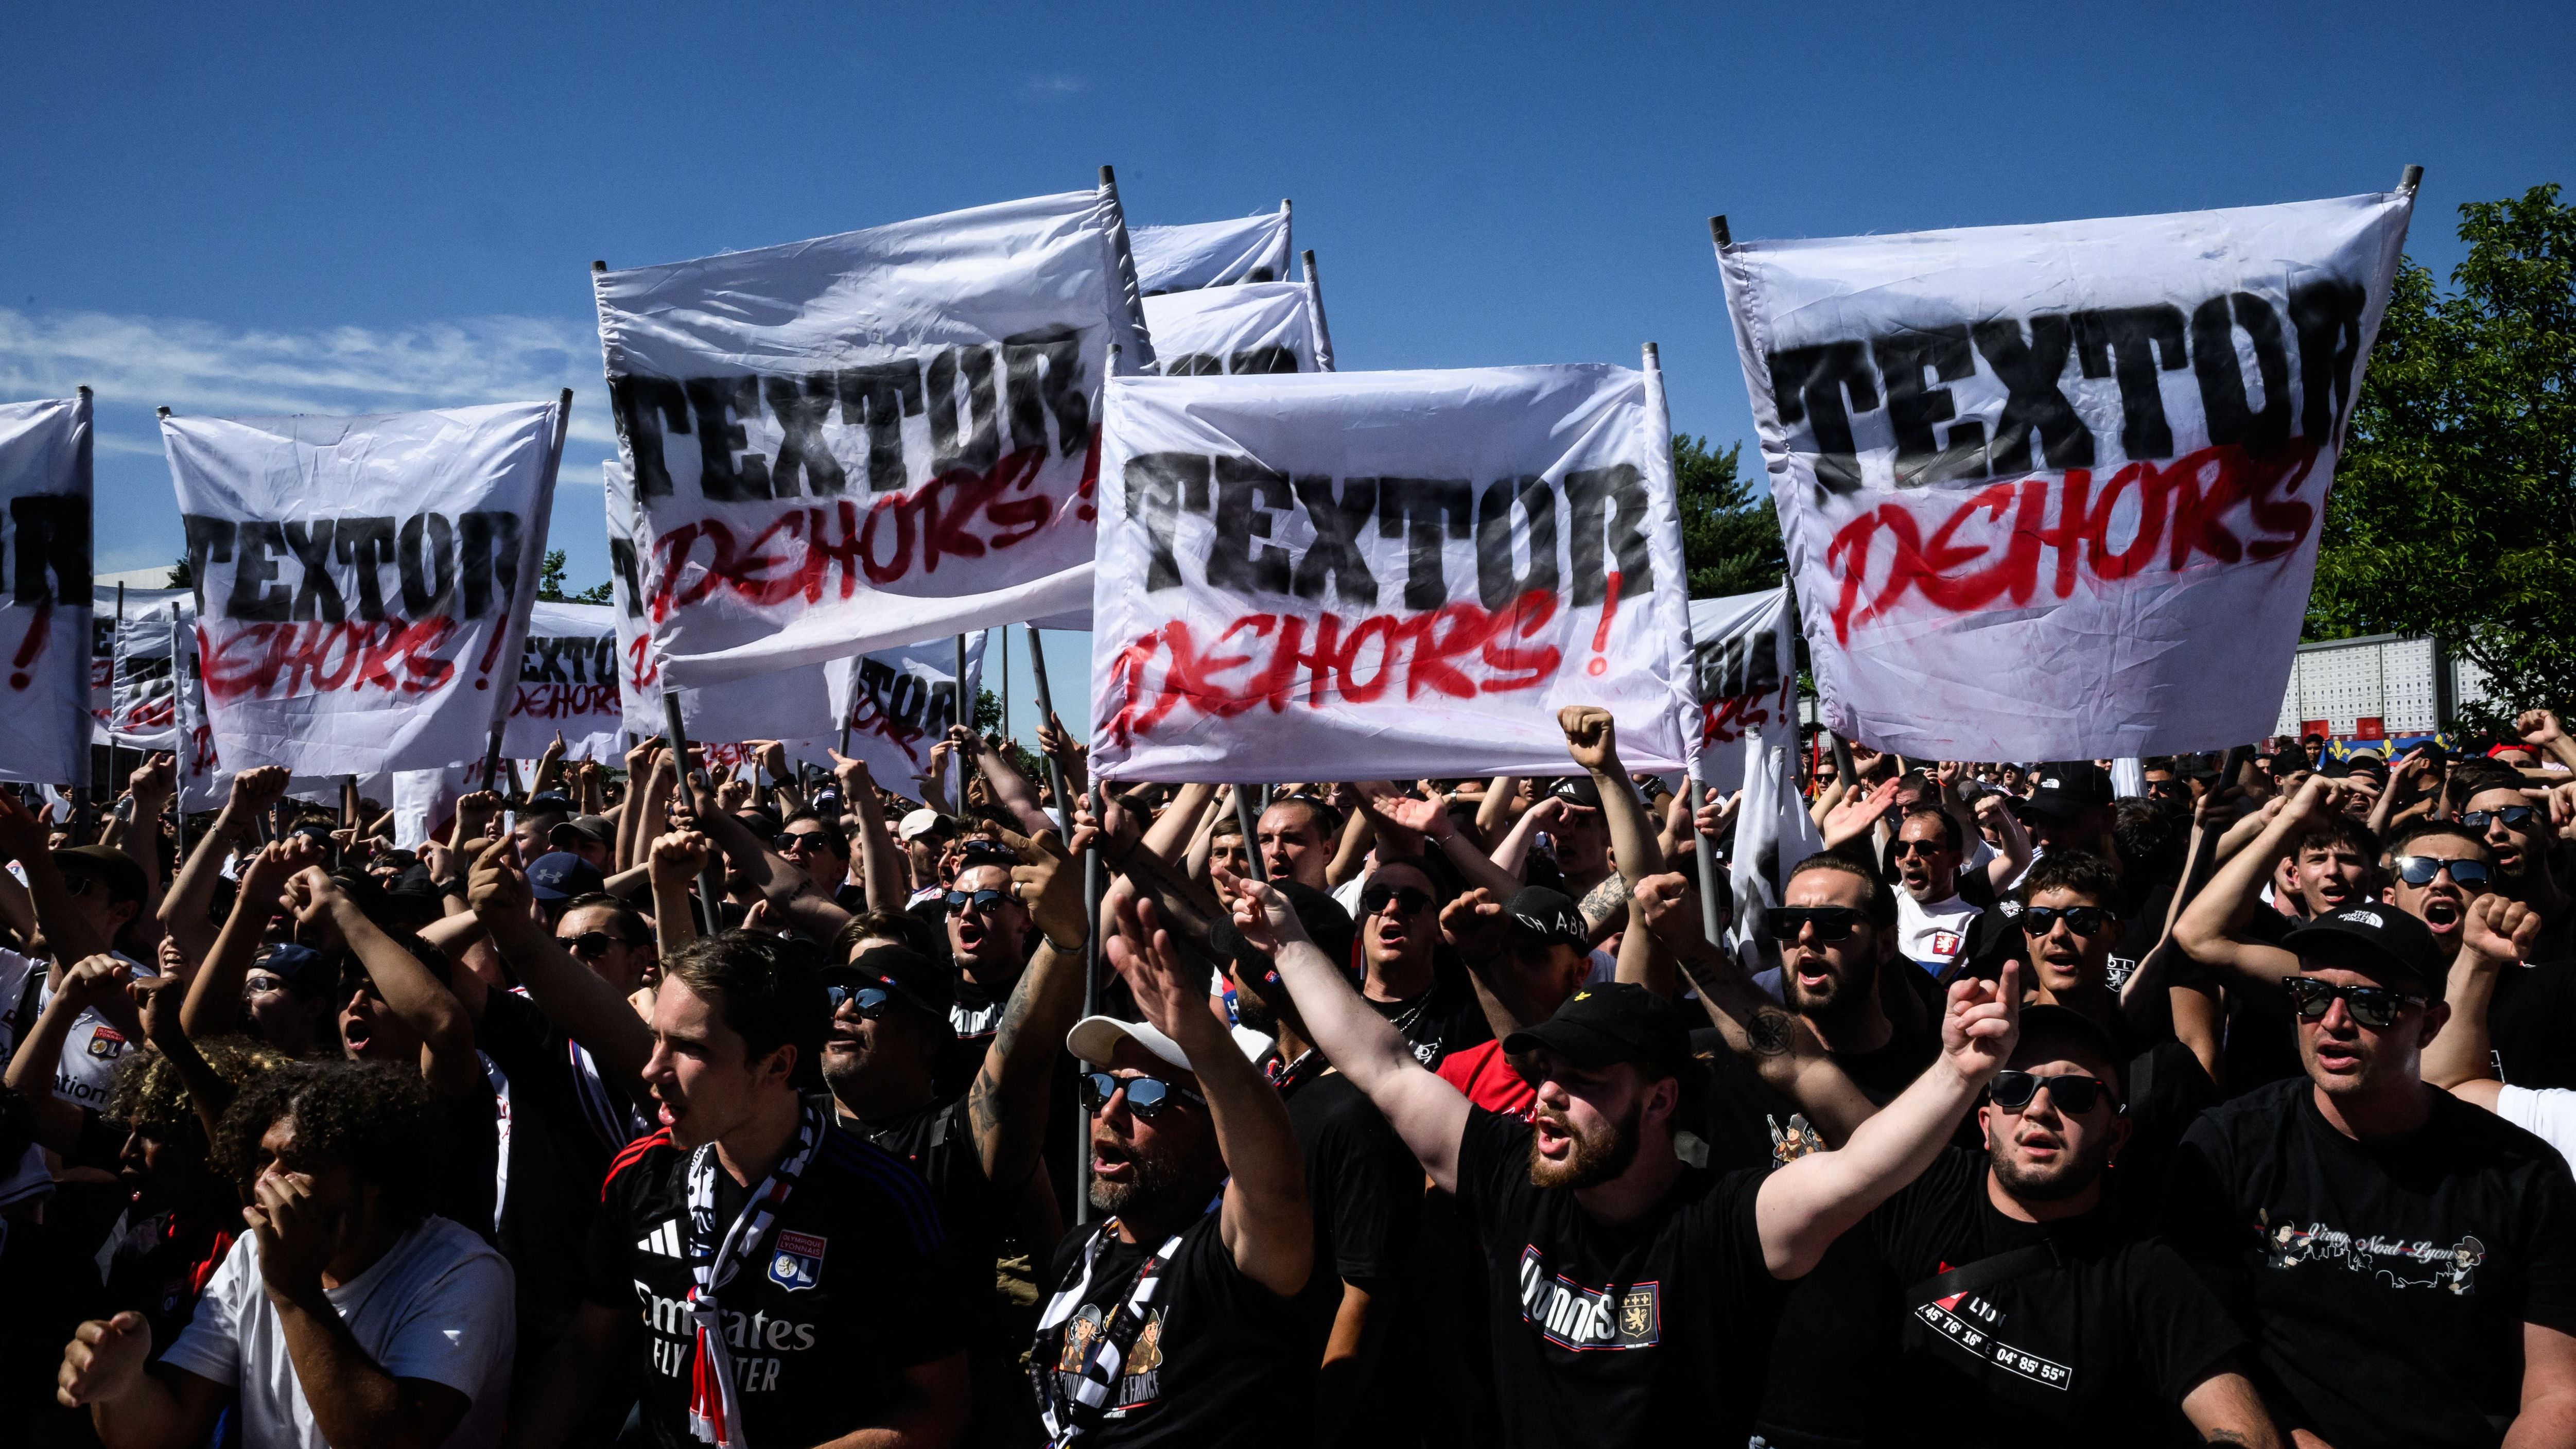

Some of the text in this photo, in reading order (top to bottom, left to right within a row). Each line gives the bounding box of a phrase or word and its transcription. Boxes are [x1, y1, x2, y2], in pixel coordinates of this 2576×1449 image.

[1770, 278, 2367, 503] TEXTOR
[612, 325, 1094, 505] TEXTOR
[1125, 450, 1653, 612] TEXTOR
[780, 1241, 821, 1256] LYONNAIS
[782, 1234, 822, 1248] OLYMPIQUE
[2355, 1235, 2405, 1256] Nord
[2406, 1241, 2455, 1264] Lyon
[653, 1336, 688, 1378] FLY
